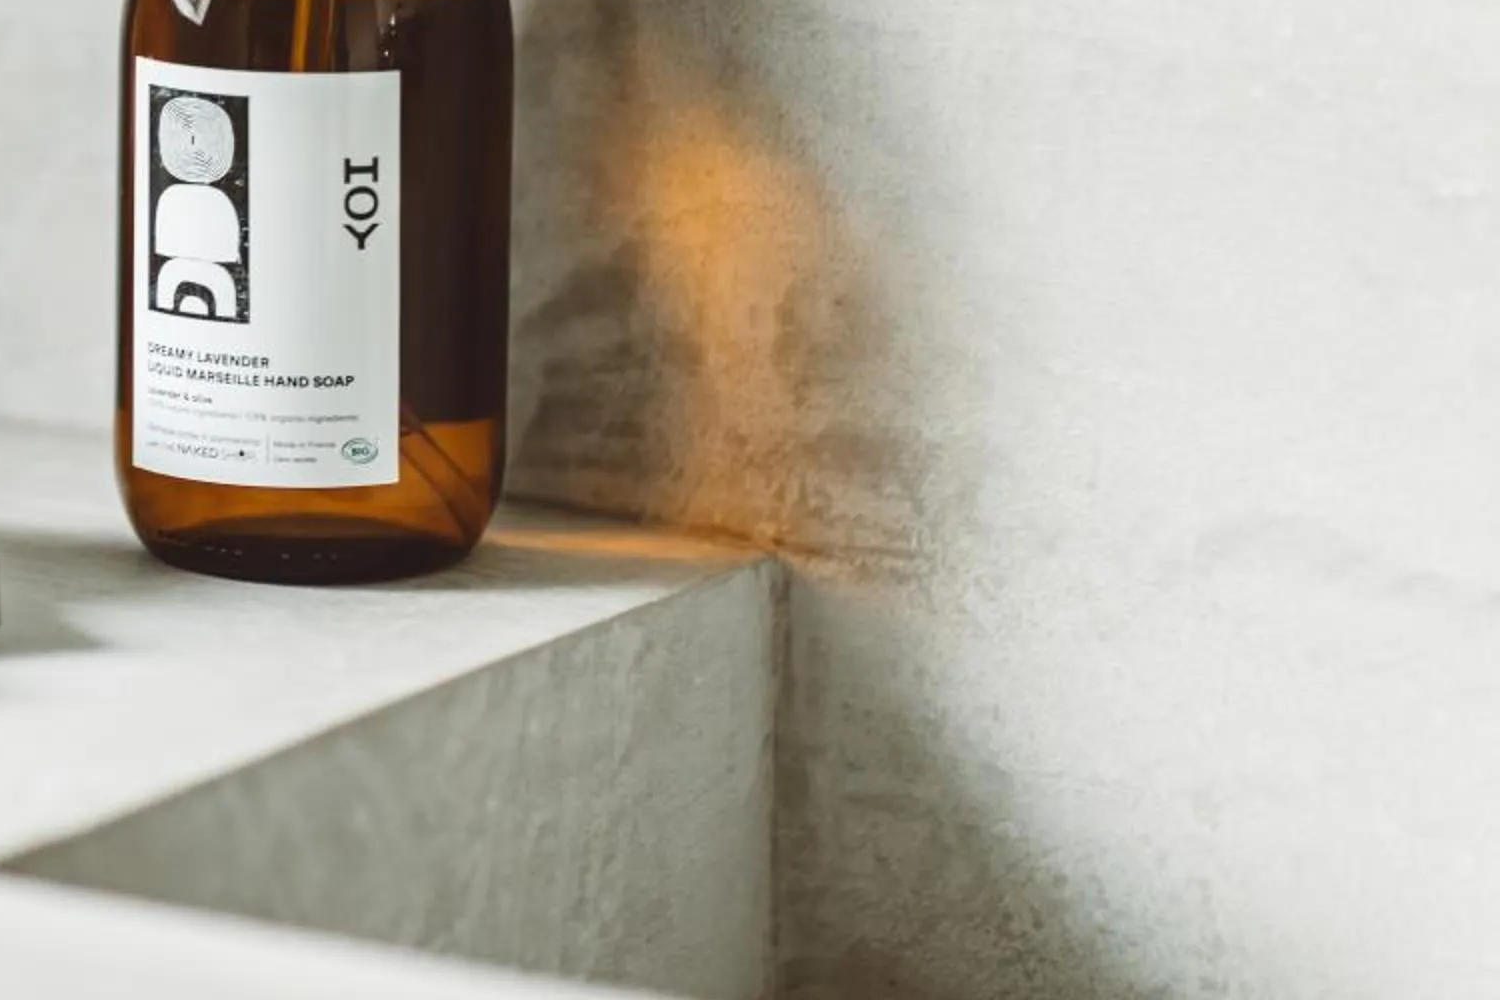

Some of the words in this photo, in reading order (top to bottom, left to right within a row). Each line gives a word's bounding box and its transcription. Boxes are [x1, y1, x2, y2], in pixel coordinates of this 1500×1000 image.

[148, 341, 194, 361] DREAMY
[197, 351, 270, 368] LAVENDER
[148, 359, 183, 378] LIQUID
[186, 367, 260, 387] MARSEILLE
[264, 376, 309, 388] HAND
[313, 375, 355, 388] SOAP
